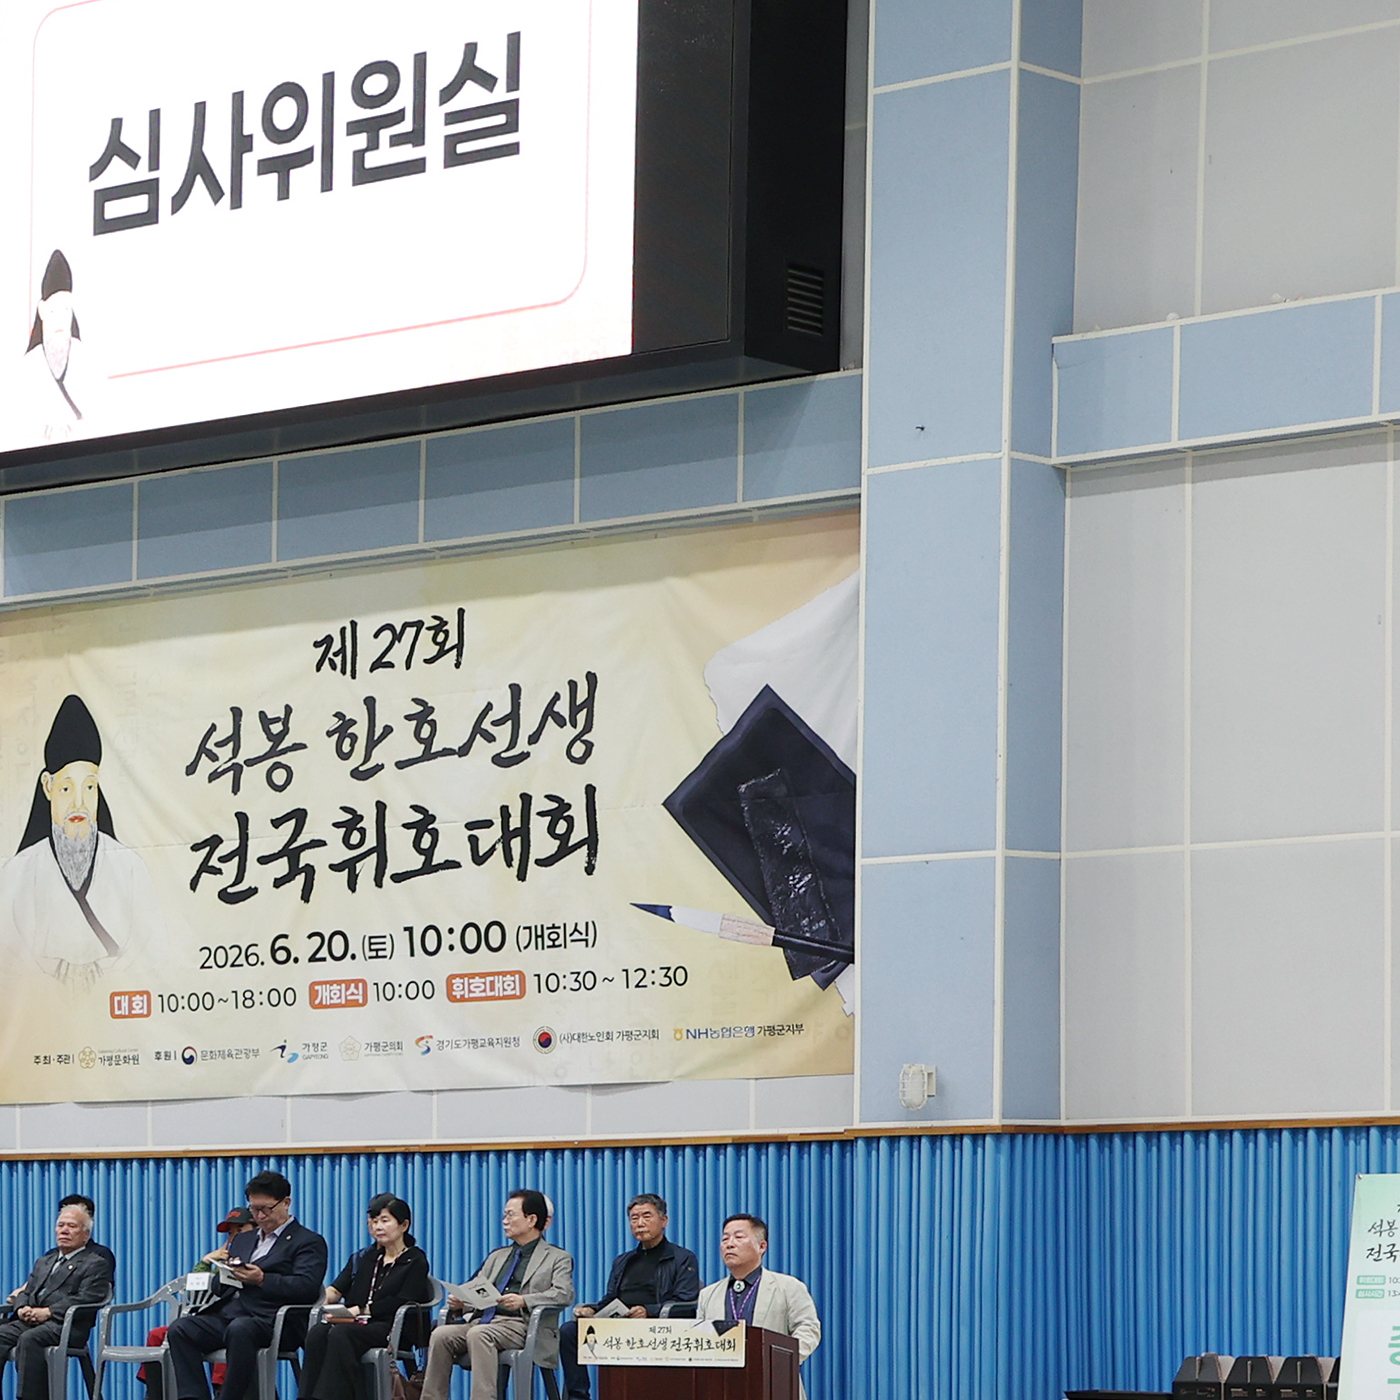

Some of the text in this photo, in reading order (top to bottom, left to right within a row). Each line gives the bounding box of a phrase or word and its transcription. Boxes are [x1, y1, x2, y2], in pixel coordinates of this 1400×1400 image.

[88, 31, 522, 236] 심사위원실
[185, 671, 598, 796] 석봉 한호선생
[189, 783, 600, 904] 전국휘호대회
[199, 943, 265, 970] 2026.
[269, 932, 300, 966] 6.
[403, 919, 507, 959] 10:00
[515, 919, 598, 953] (개회식)
[313, 981, 364, 1005] 개회식
[373, 979, 436, 1003] 10:00
[450, 974, 523, 999] 휘호대회
[559, 1028, 660, 1045] (사)대한노인회 가평군지회
[756, 1022, 805, 1038] 가평군지부
[302, 1041, 328, 1053] 가평군
[364, 1040, 404, 1053] 가평군의회
[435, 1034, 521, 1051] 경기도가평교육지원청
[97, 1053, 141, 1066] 가평문화원
[154, 1050, 172, 1061] 후원
[200, 1047, 260, 1061] 문화체육관광부
[1367, 1218, 1398, 1238] 석봉
[603, 1336, 737, 1353] 석봉 한호선생 전국휘호대회
